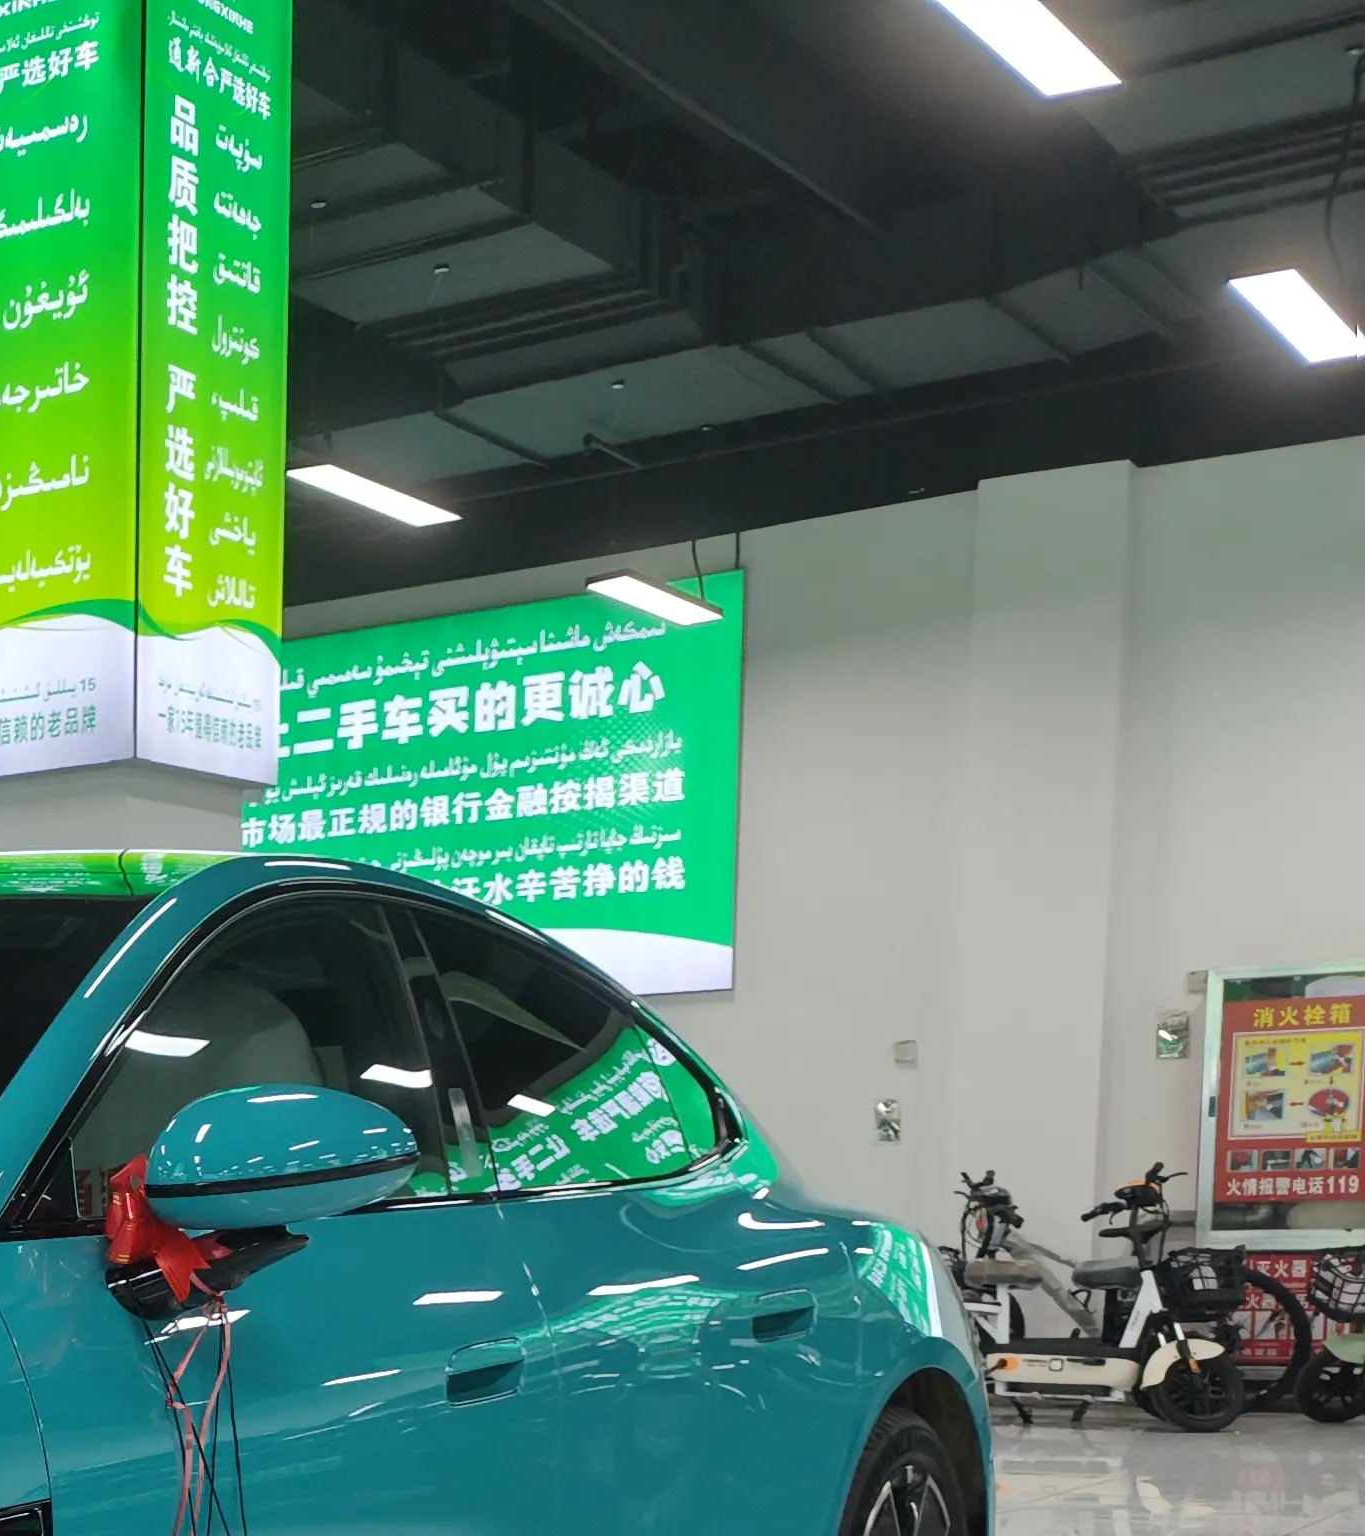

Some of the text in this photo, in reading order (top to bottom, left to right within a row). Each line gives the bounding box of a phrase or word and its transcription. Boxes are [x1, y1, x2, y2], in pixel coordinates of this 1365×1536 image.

[168, 37, 272, 120] 通新合严选好车
[162, 94, 200, 598] 品质把控 严选好车
[208, 512, 257, 556] ياخشى
[206, 574, 256, 609] تاللاش
[80, 677, 97, 692] 15
[240, 766, 686, 849] 市场最正规的银行金融按揭渠道
[434, 855, 686, 906] 汗水辛苦挣的钱
[1252, 1002, 1353, 1029] 消火栓箱
[1225, 1174, 1360, 1197] 火情报警电话119
